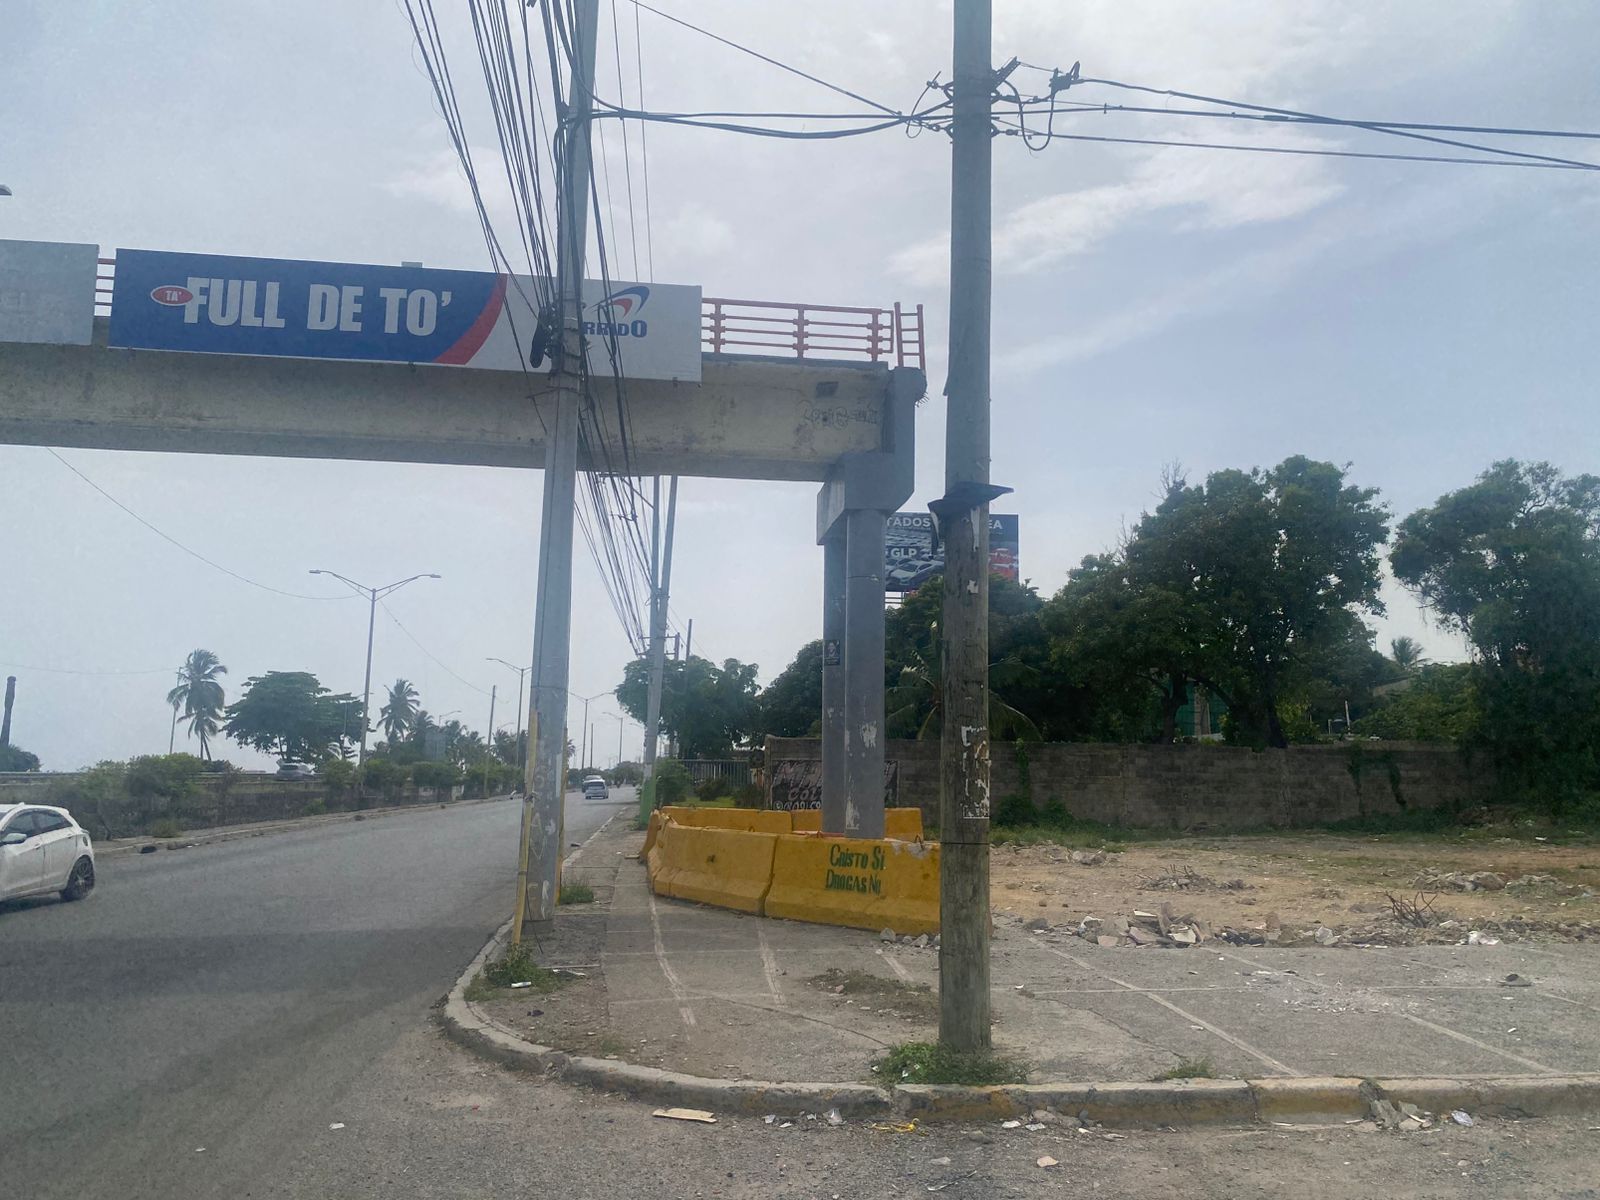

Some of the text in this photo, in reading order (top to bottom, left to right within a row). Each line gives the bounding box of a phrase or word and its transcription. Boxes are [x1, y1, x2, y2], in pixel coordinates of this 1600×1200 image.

[184, 277, 452, 336] FULL DE TO'
[887, 517, 931, 528] TADOS
[890, 548, 918, 558] GLP
